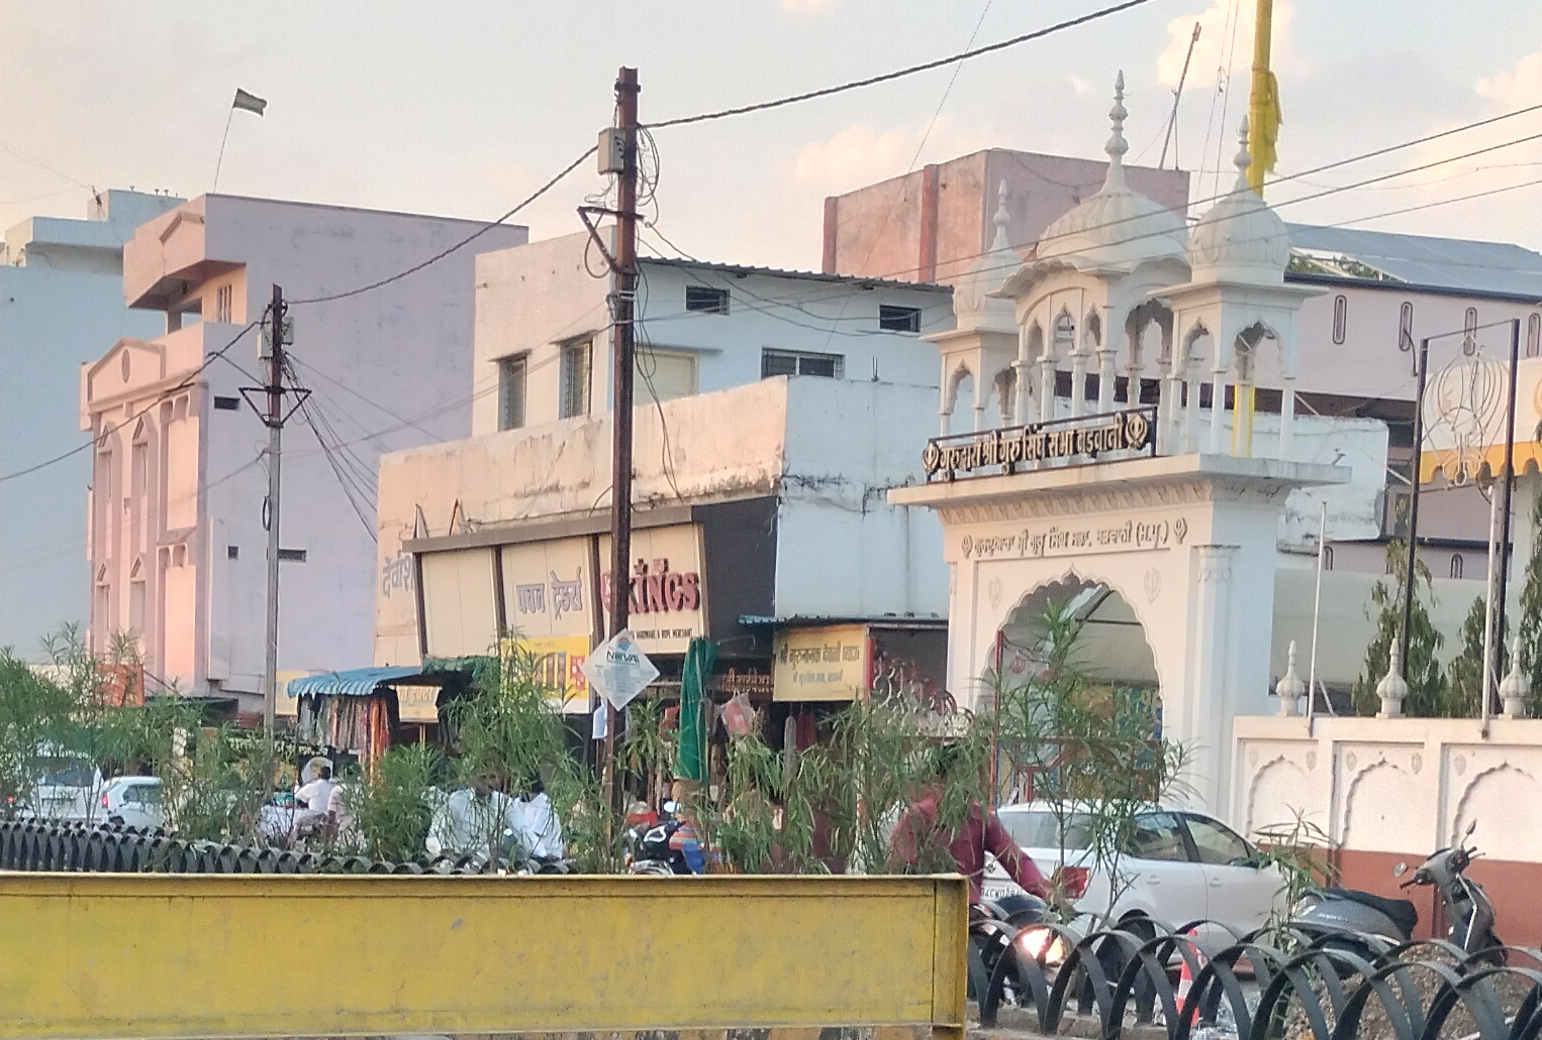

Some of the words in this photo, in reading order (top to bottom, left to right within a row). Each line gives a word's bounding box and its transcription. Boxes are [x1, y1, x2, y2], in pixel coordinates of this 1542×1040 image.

[984, 429, 999, 466] श्री
[1047, 431, 1073, 457] सभा
[606, 650, 640, 663] NOVA
